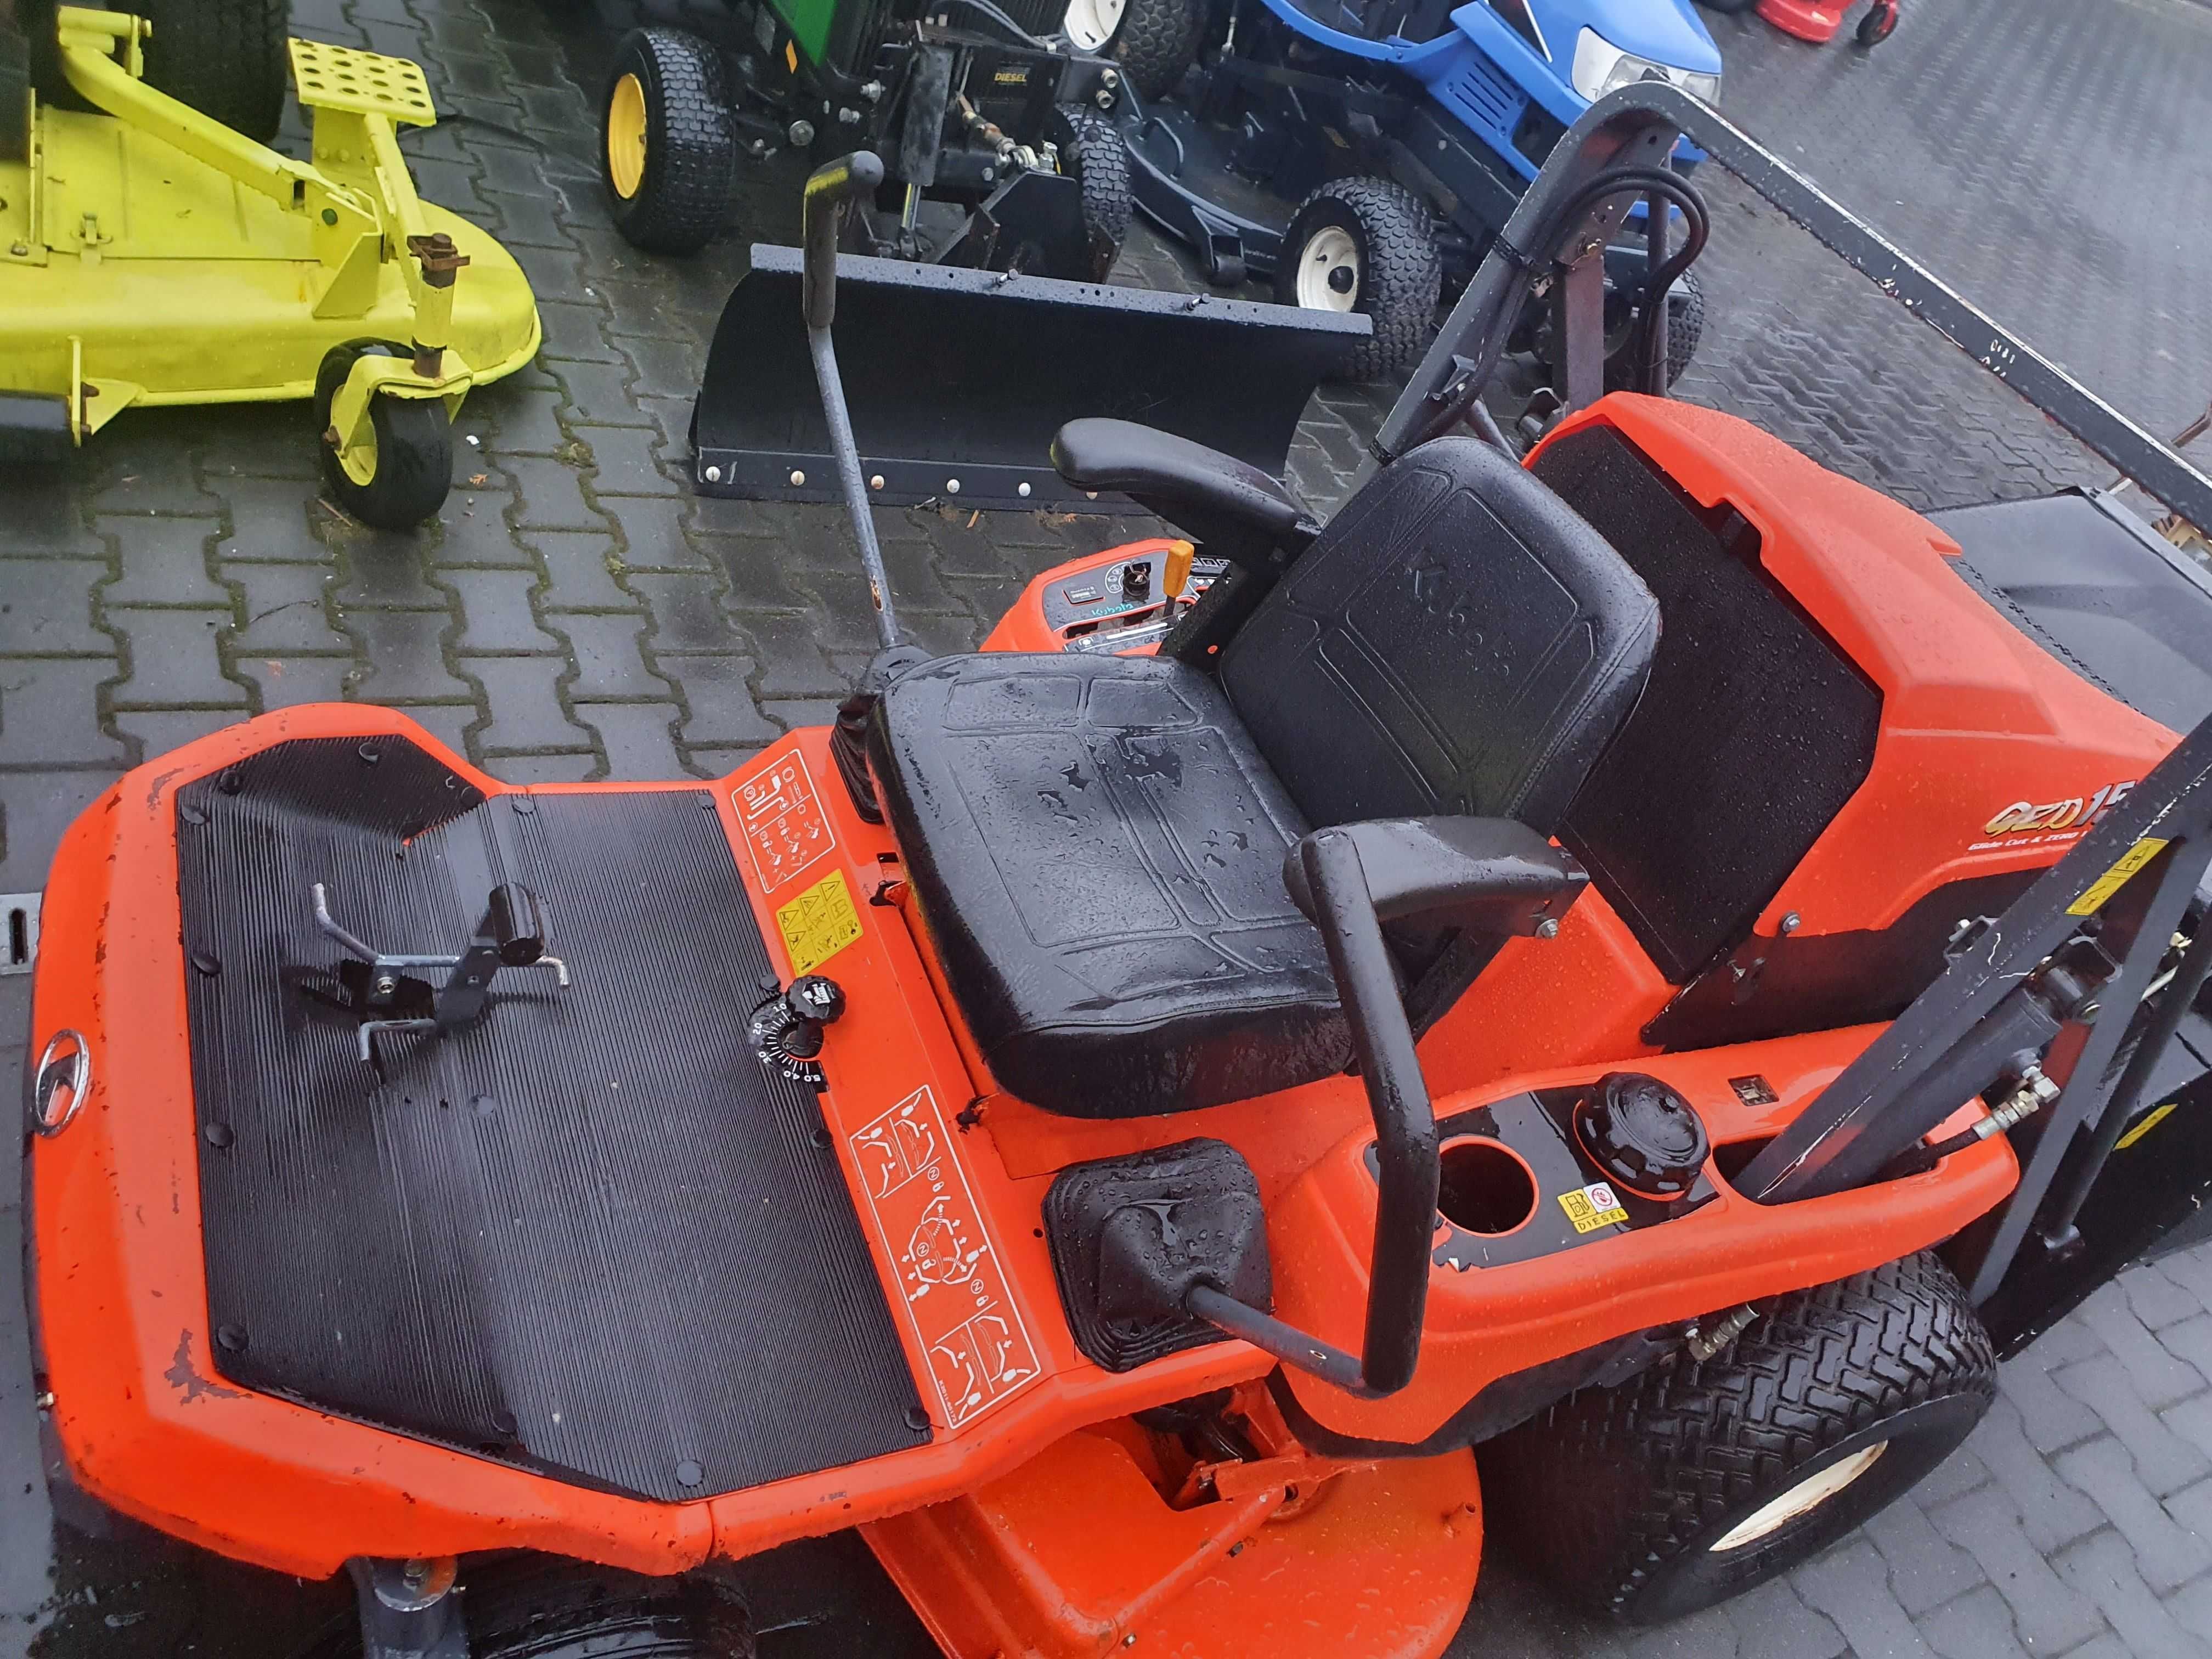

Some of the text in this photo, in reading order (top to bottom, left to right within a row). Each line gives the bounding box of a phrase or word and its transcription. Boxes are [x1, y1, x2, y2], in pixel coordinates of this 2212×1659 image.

[995, 73, 1027, 82] DIESEL
[1091, 603, 1134, 615] Kubota
[1968, 841, 2003, 851] Glide
[2005, 838, 2029, 847] Cut
[2044, 832, 2080, 842] ZERO
[1578, 1210, 1626, 1231] DIESEL
